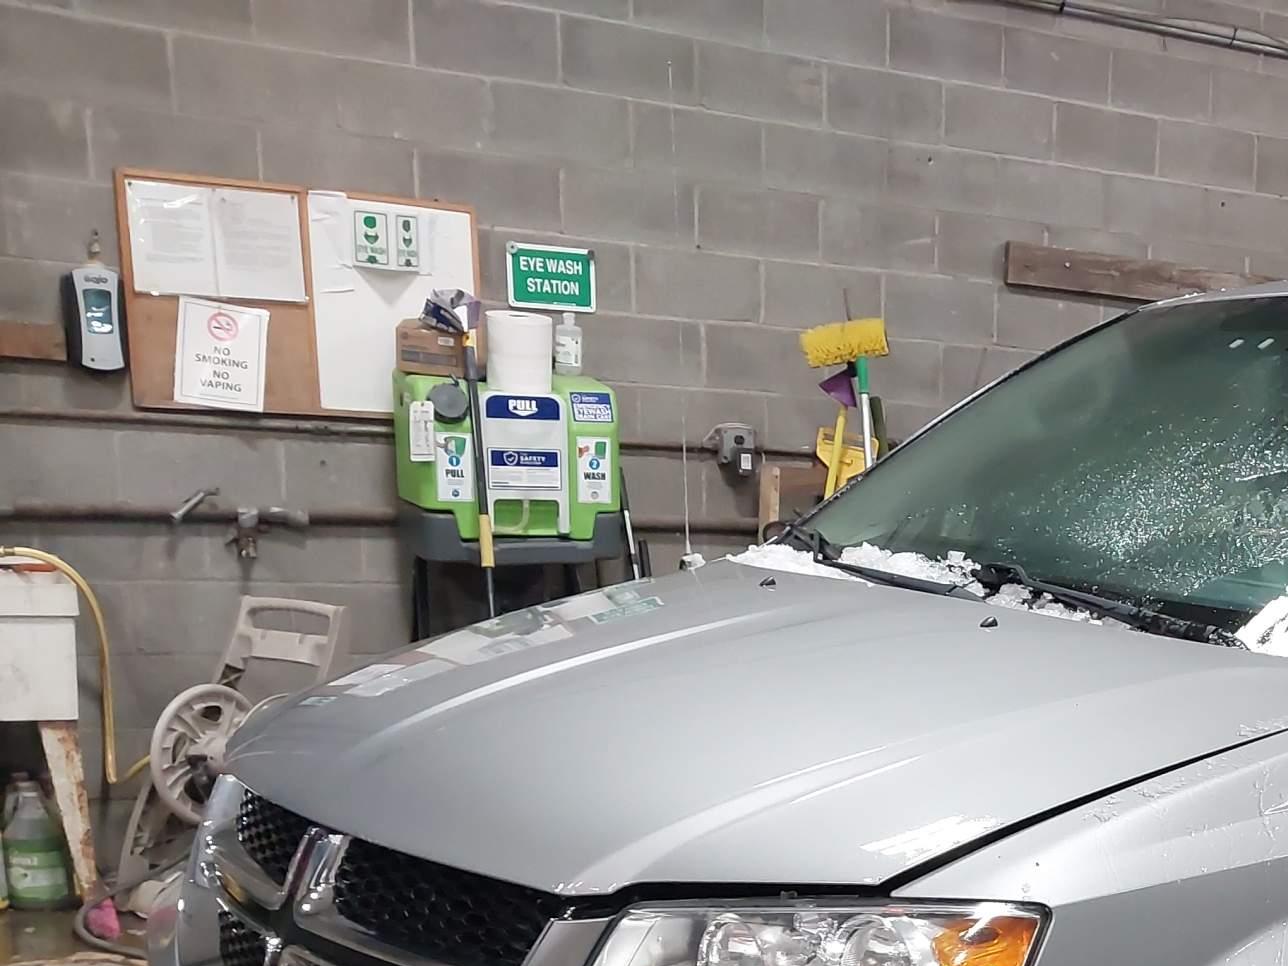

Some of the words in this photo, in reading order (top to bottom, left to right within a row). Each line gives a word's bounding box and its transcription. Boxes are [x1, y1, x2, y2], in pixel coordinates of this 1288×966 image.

[519, 255, 545, 272] EYE
[545, 258, 583, 275] WASH
[526, 277, 580, 296] STATION
[214, 346, 231, 356] NO
[194, 353, 249, 370] SMOKING
[212, 370, 230, 380] NO
[199, 379, 242, 392] VAPING
[508, 399, 538, 411] PULL
[445, 469, 464, 478] PULL
[583, 472, 606, 481] WASH
